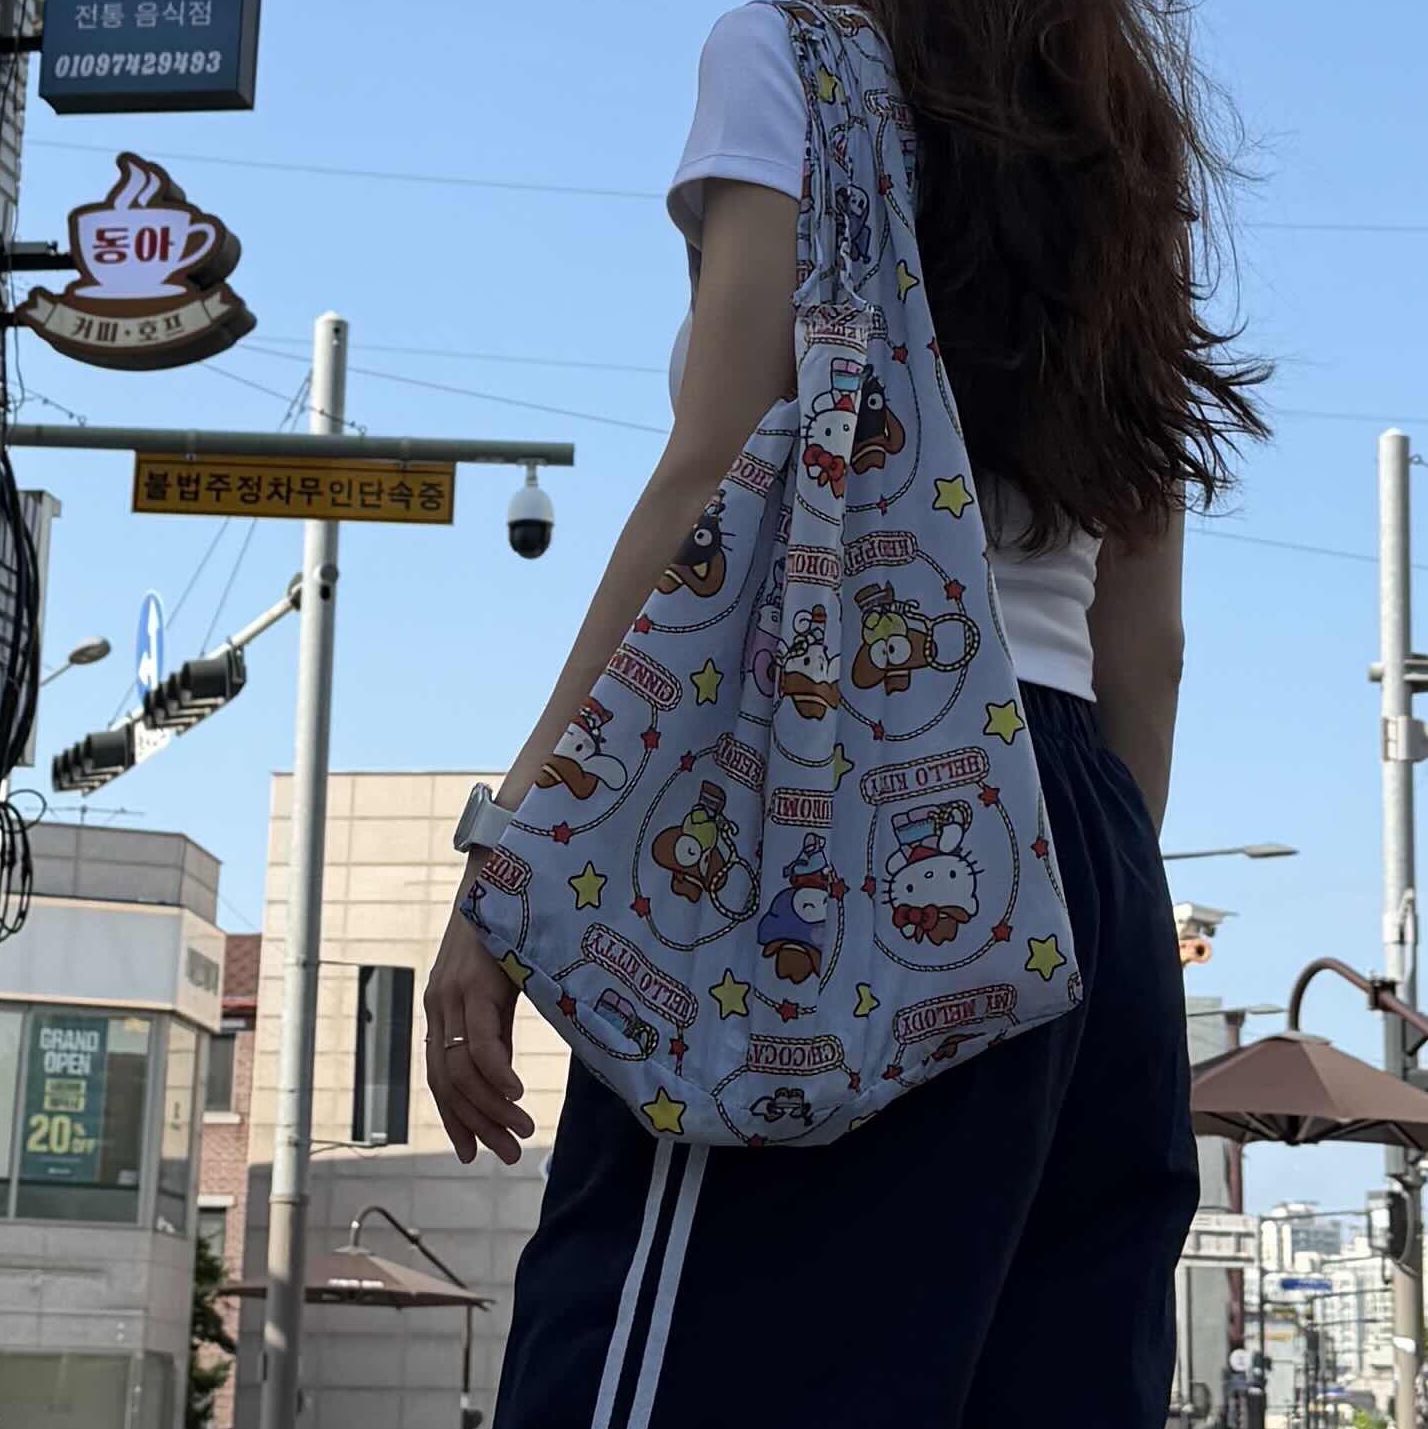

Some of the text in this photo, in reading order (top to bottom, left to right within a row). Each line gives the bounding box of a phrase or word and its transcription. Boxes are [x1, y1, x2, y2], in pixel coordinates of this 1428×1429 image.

[75, 0, 213, 28] 전통 음식점
[55, 51, 221, 78] 01097429493
[93, 226, 175, 264] 동아
[144, 470, 445, 513] 불법주정차무인단속중
[916, 757, 981, 787] HELLO
[590, 935, 641, 976] KITTY
[901, 992, 1011, 1037] MY MELODY
[40, 1028, 99, 1052] GRAND
[44, 1051, 91, 1075] OPEN
[748, 1043, 836, 1069] CHCOCA
